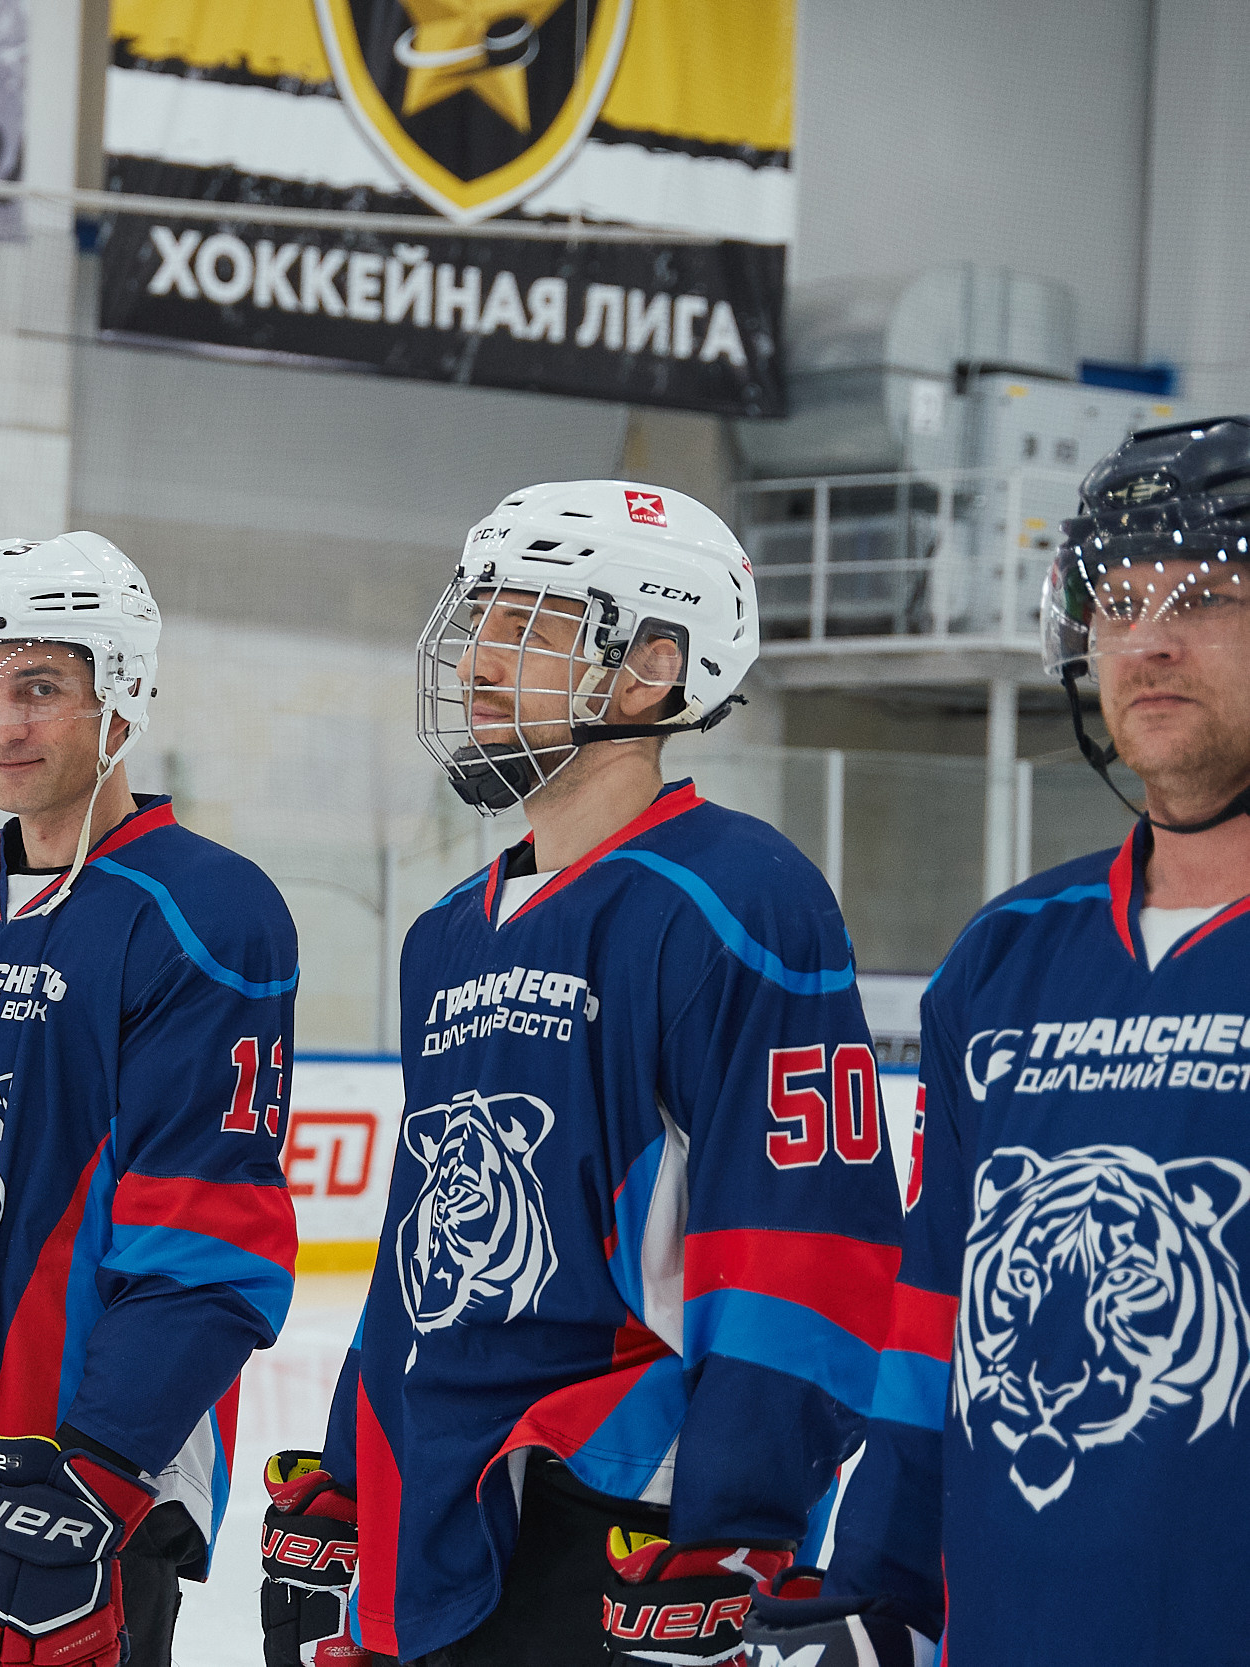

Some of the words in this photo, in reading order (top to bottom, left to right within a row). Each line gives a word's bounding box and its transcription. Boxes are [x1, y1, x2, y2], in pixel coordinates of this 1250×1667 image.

[150, 224, 569, 348] ХОККЕЙНАЯ
[575, 282, 747, 367] ЛИГА
[638, 581, 702, 605] CCM
[1029, 1014, 1250, 1060] ТРАНСНЕ
[1014, 1053, 1169, 1094] ДАЛЬНИЙ
[766, 1043, 882, 1170] 50
